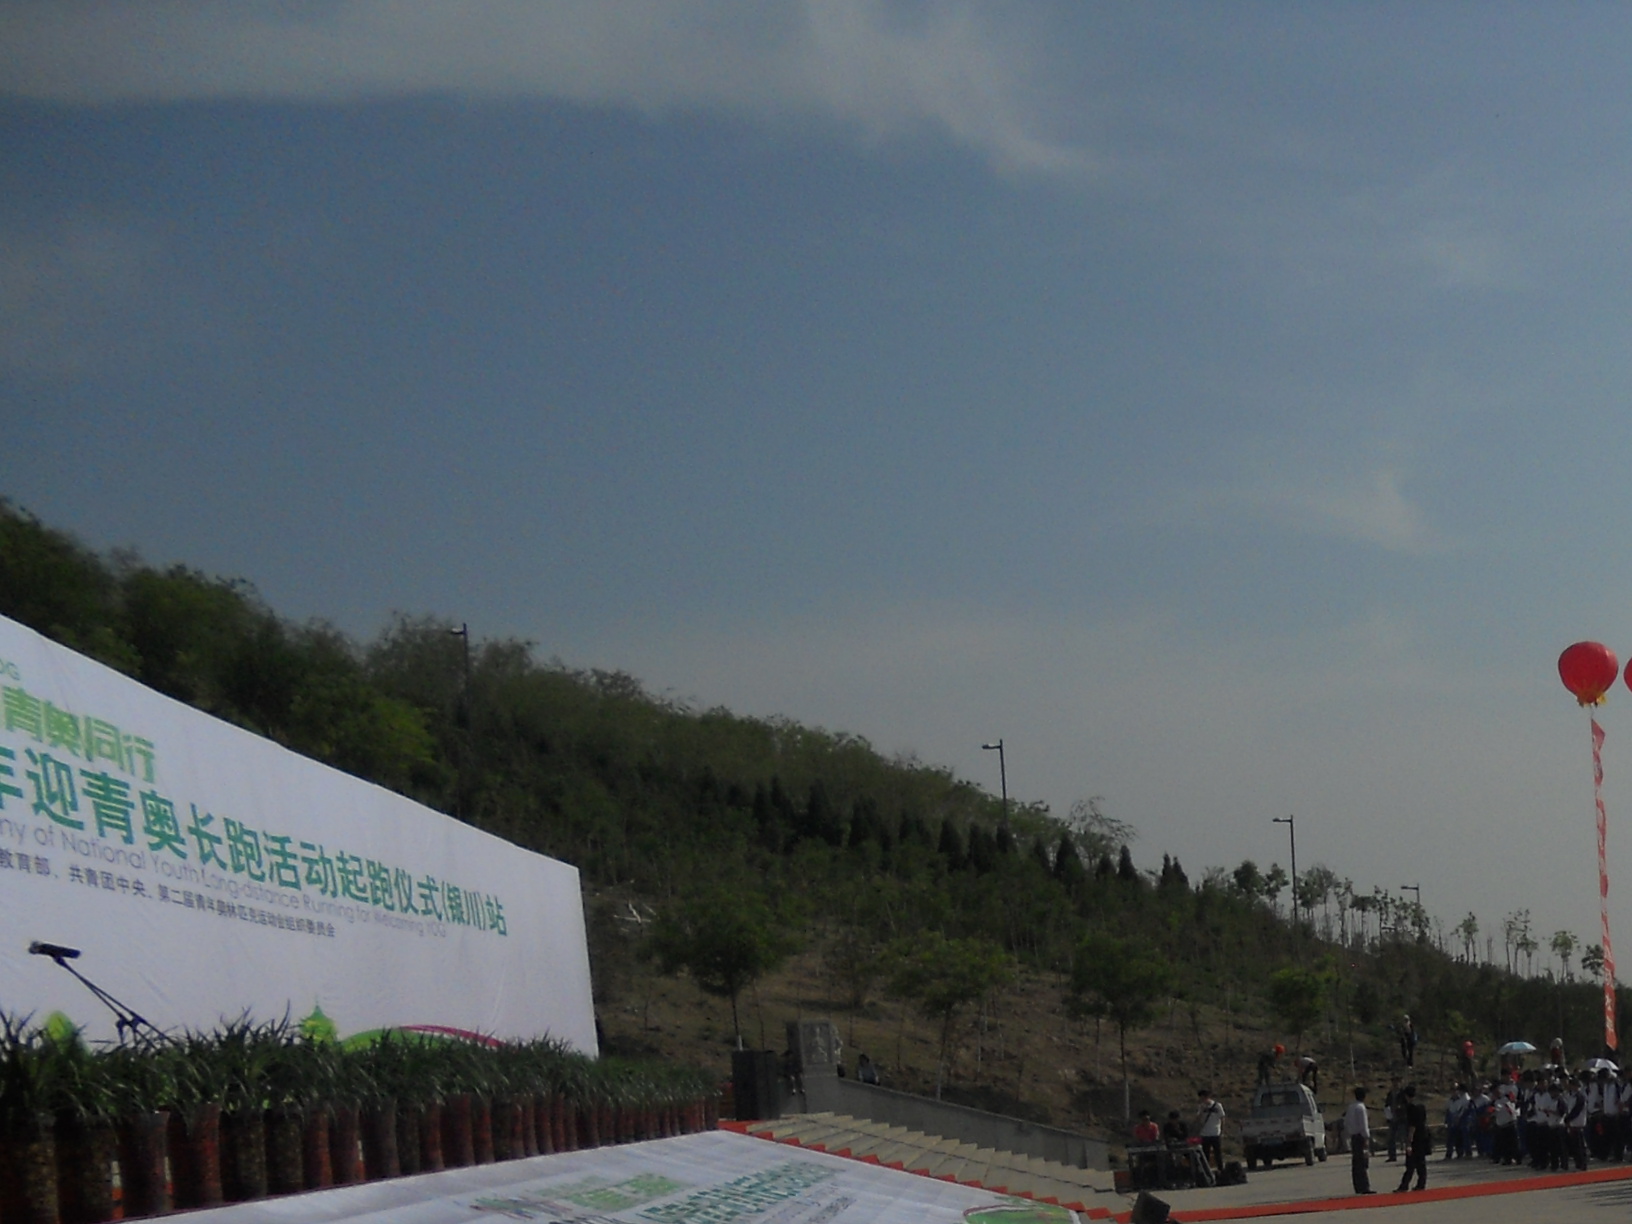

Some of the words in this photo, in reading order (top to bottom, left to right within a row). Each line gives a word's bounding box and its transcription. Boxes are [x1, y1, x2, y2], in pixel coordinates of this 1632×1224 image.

[34, 824, 55, 846] of
[62, 829, 146, 869] National
[150, 850, 199, 883] Youth
